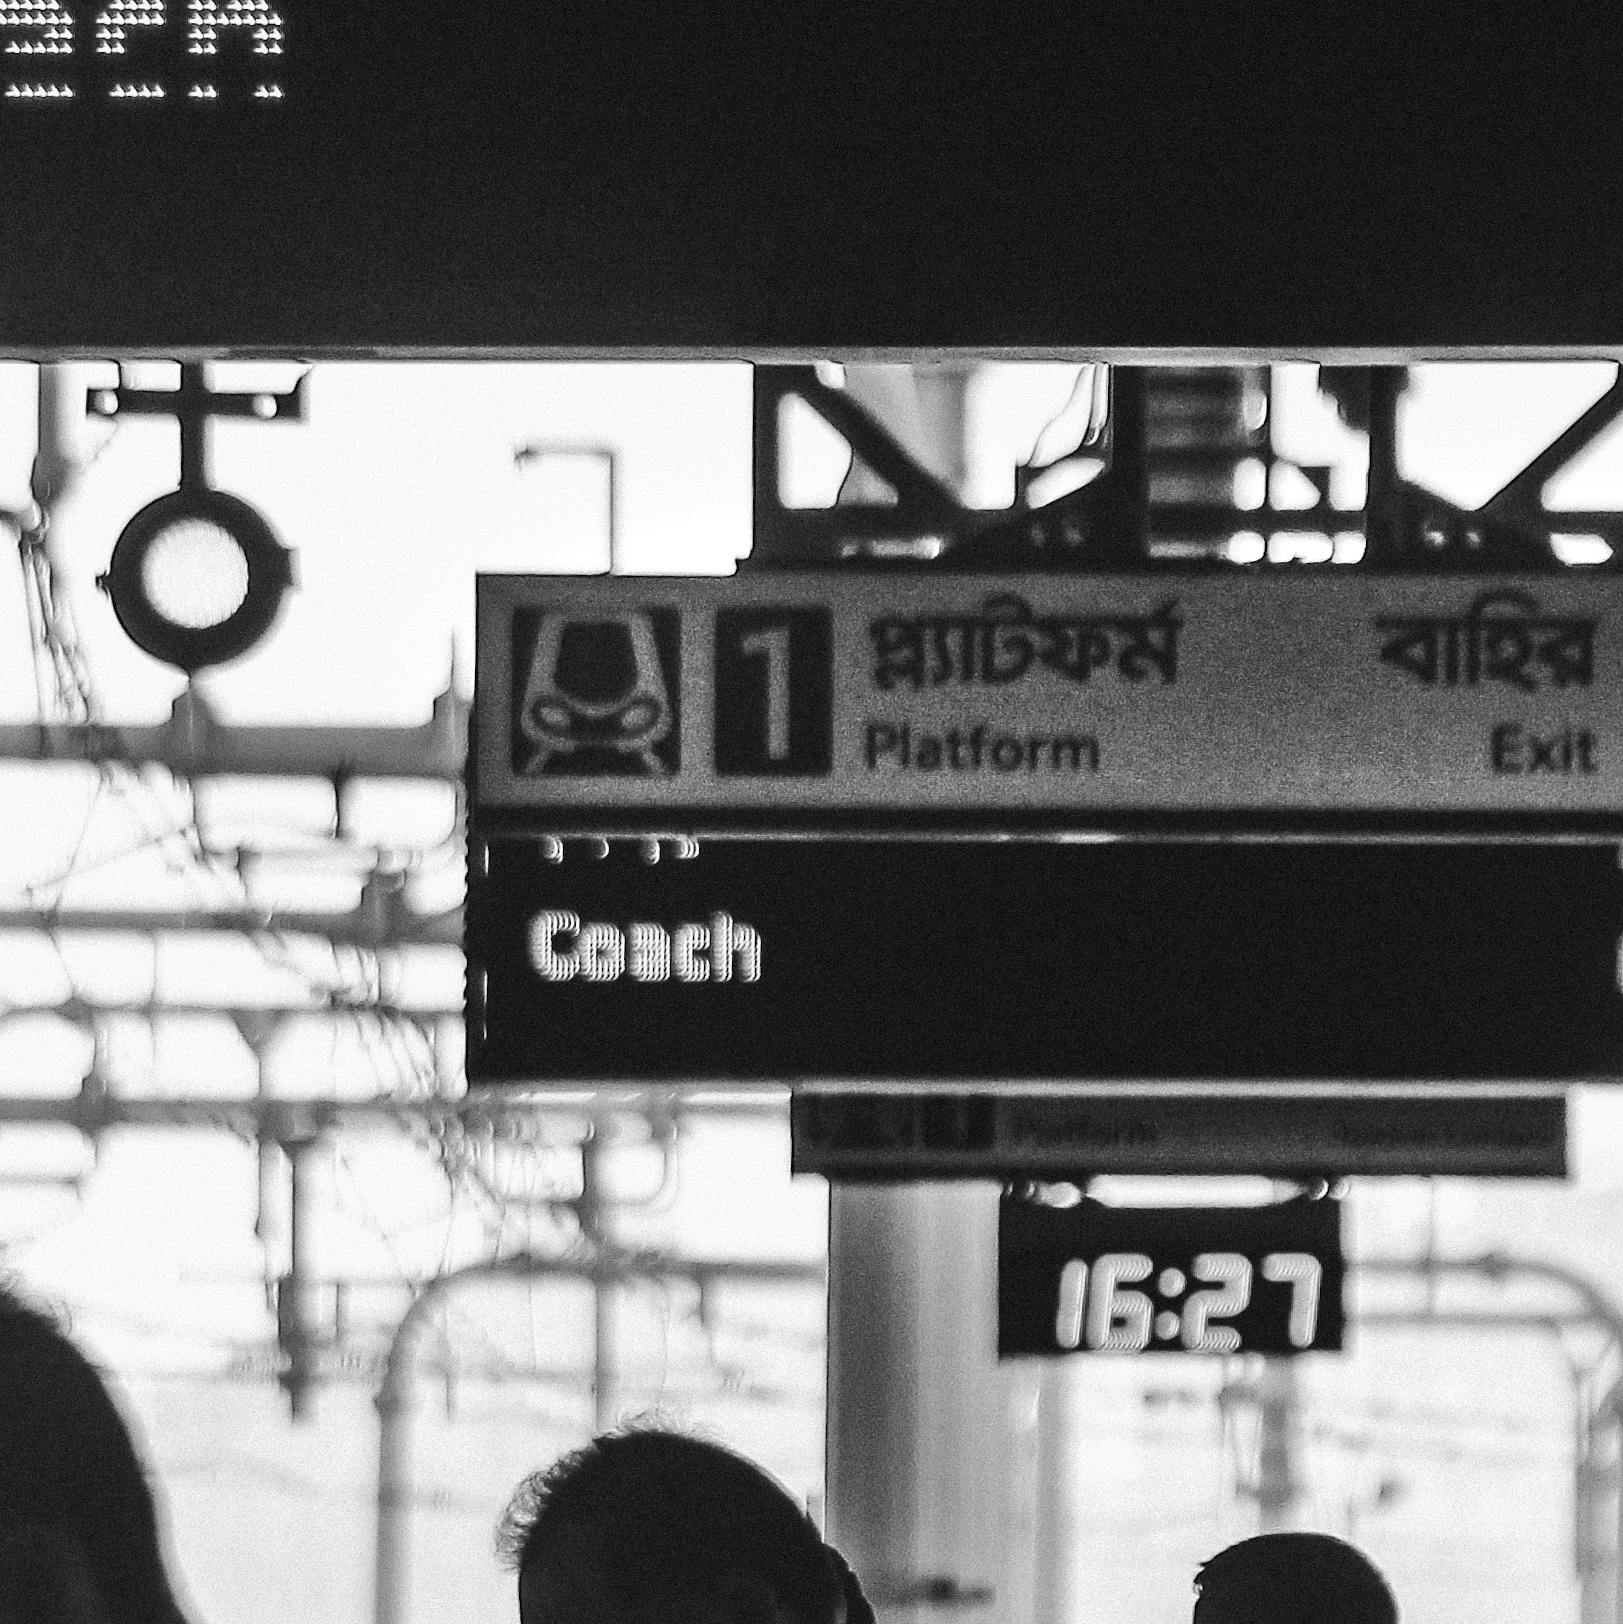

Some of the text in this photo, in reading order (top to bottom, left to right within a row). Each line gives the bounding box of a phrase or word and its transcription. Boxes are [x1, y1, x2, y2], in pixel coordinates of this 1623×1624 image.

[1376, 587, 1596, 692] বাহির
[741, 628, 790, 760] 1
[864, 722, 1100, 773] Platform
[1489, 722, 1597, 774] Exit
[529, 910, 761, 983] Coach
[1056, 1252, 1322, 1351] 16:27
